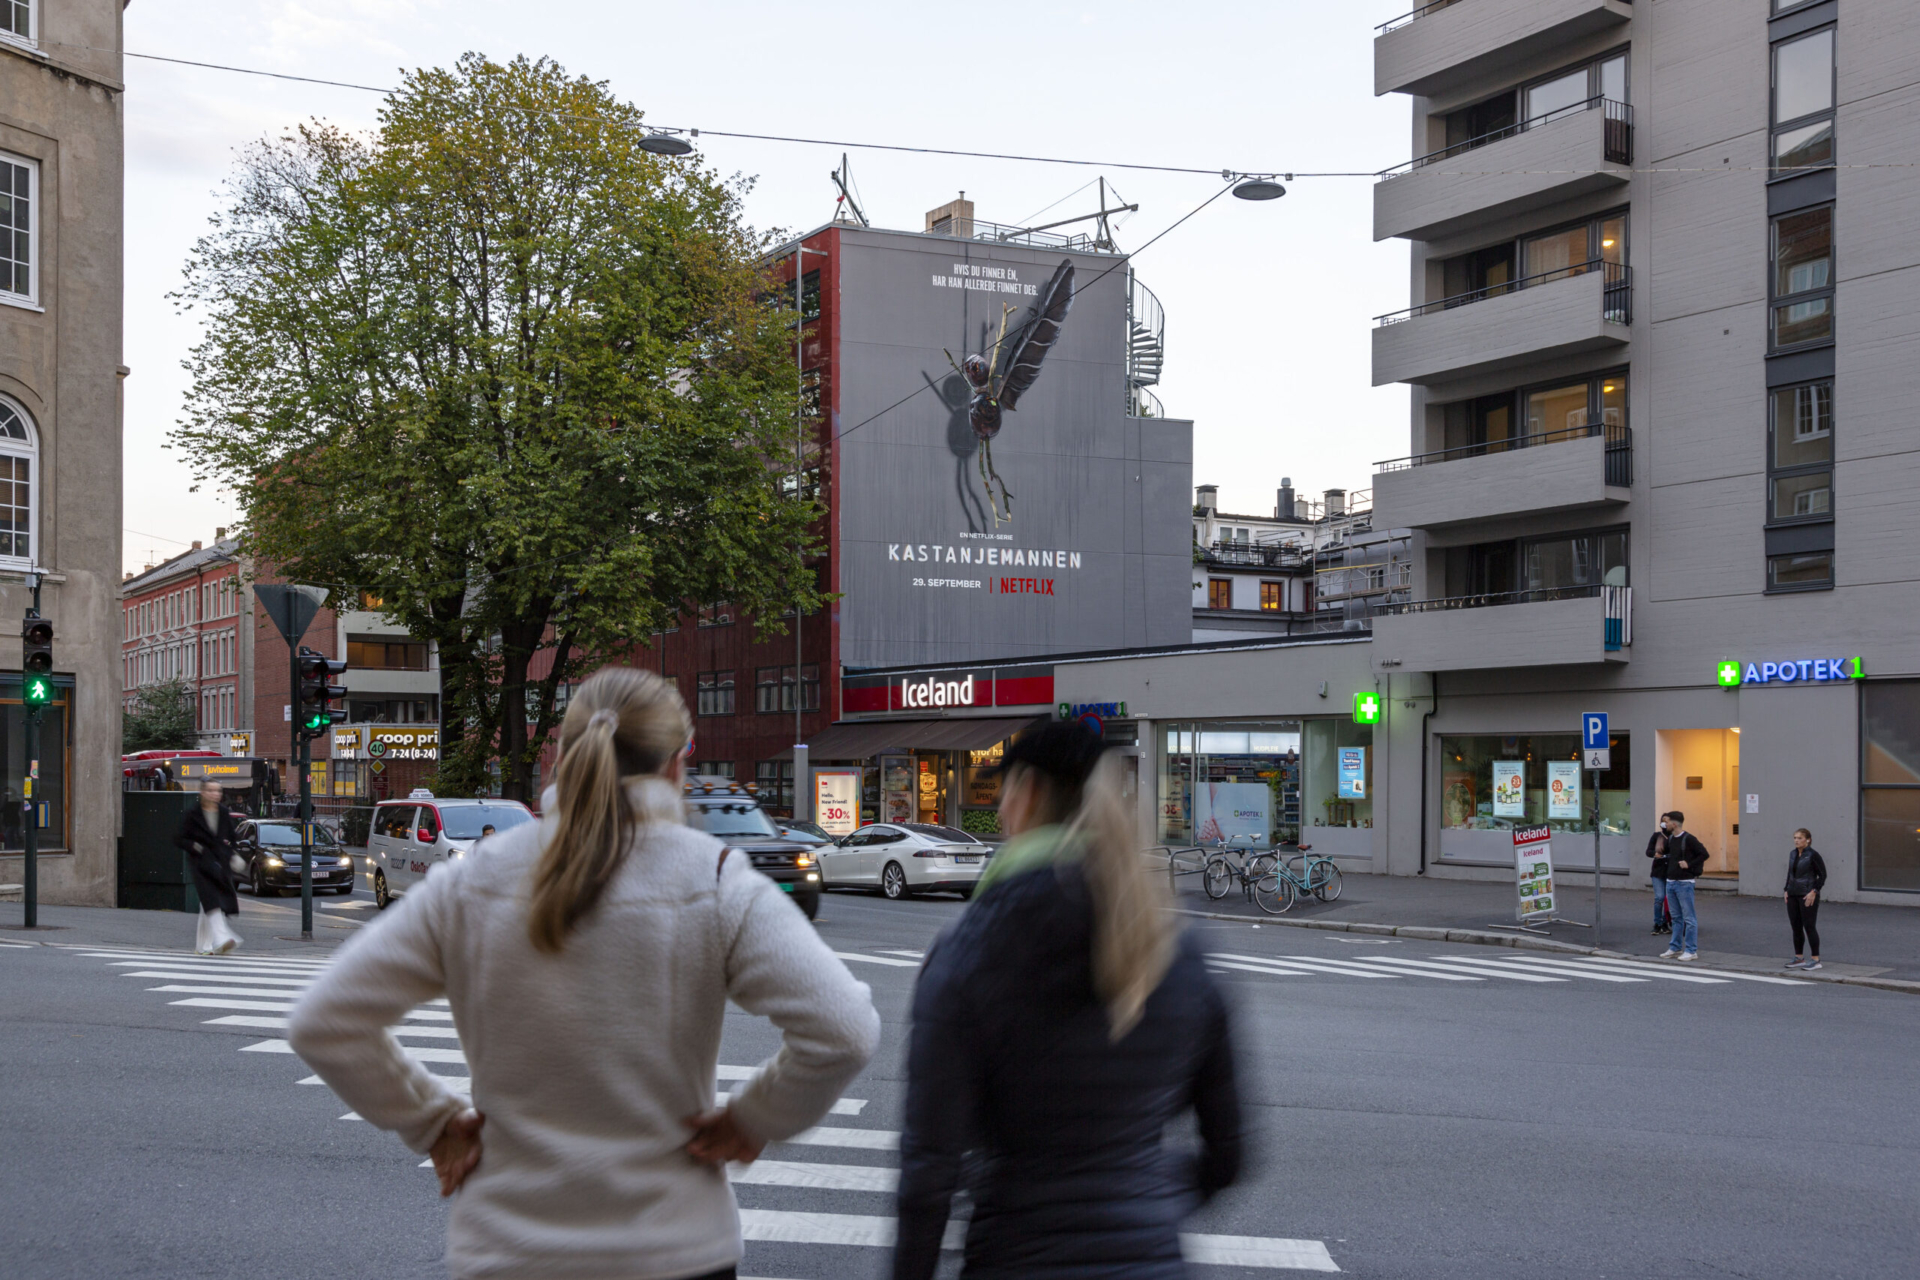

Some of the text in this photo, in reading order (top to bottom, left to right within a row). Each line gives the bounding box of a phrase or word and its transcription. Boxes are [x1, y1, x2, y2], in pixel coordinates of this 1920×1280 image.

[954, 264, 1018, 282] HVIS DU FINNER ÉN,
[932, 275, 1038, 296] HAR HAN ALLEREDE FUNNET DEG.
[969, 532, 1013, 540] NETFLIX-SERIE
[888, 544, 1081, 569] KASTANJEMANNEN
[913, 577, 1054, 596] 29. SEPTEMBER NETFLIX
[1743, 656, 1865, 683] APOTEK 1
[902, 674, 973, 708] Iceland
[1071, 701, 1126, 718] APOTEK 1
[376, 730, 438, 747] coop pri
[1589, 717, 1602, 745] P
[371, 744, 384, 753] 40
[391, 747, 437, 760] 7-24 (8-24)
[181, 764, 239, 776] 21 Tjuvholmen
[822, 807, 850, 820] -30%
[1515, 825, 1549, 842] Iceland
[1523, 848, 1544, 858] Iceland
[410, 861, 430, 874] OsloTax
